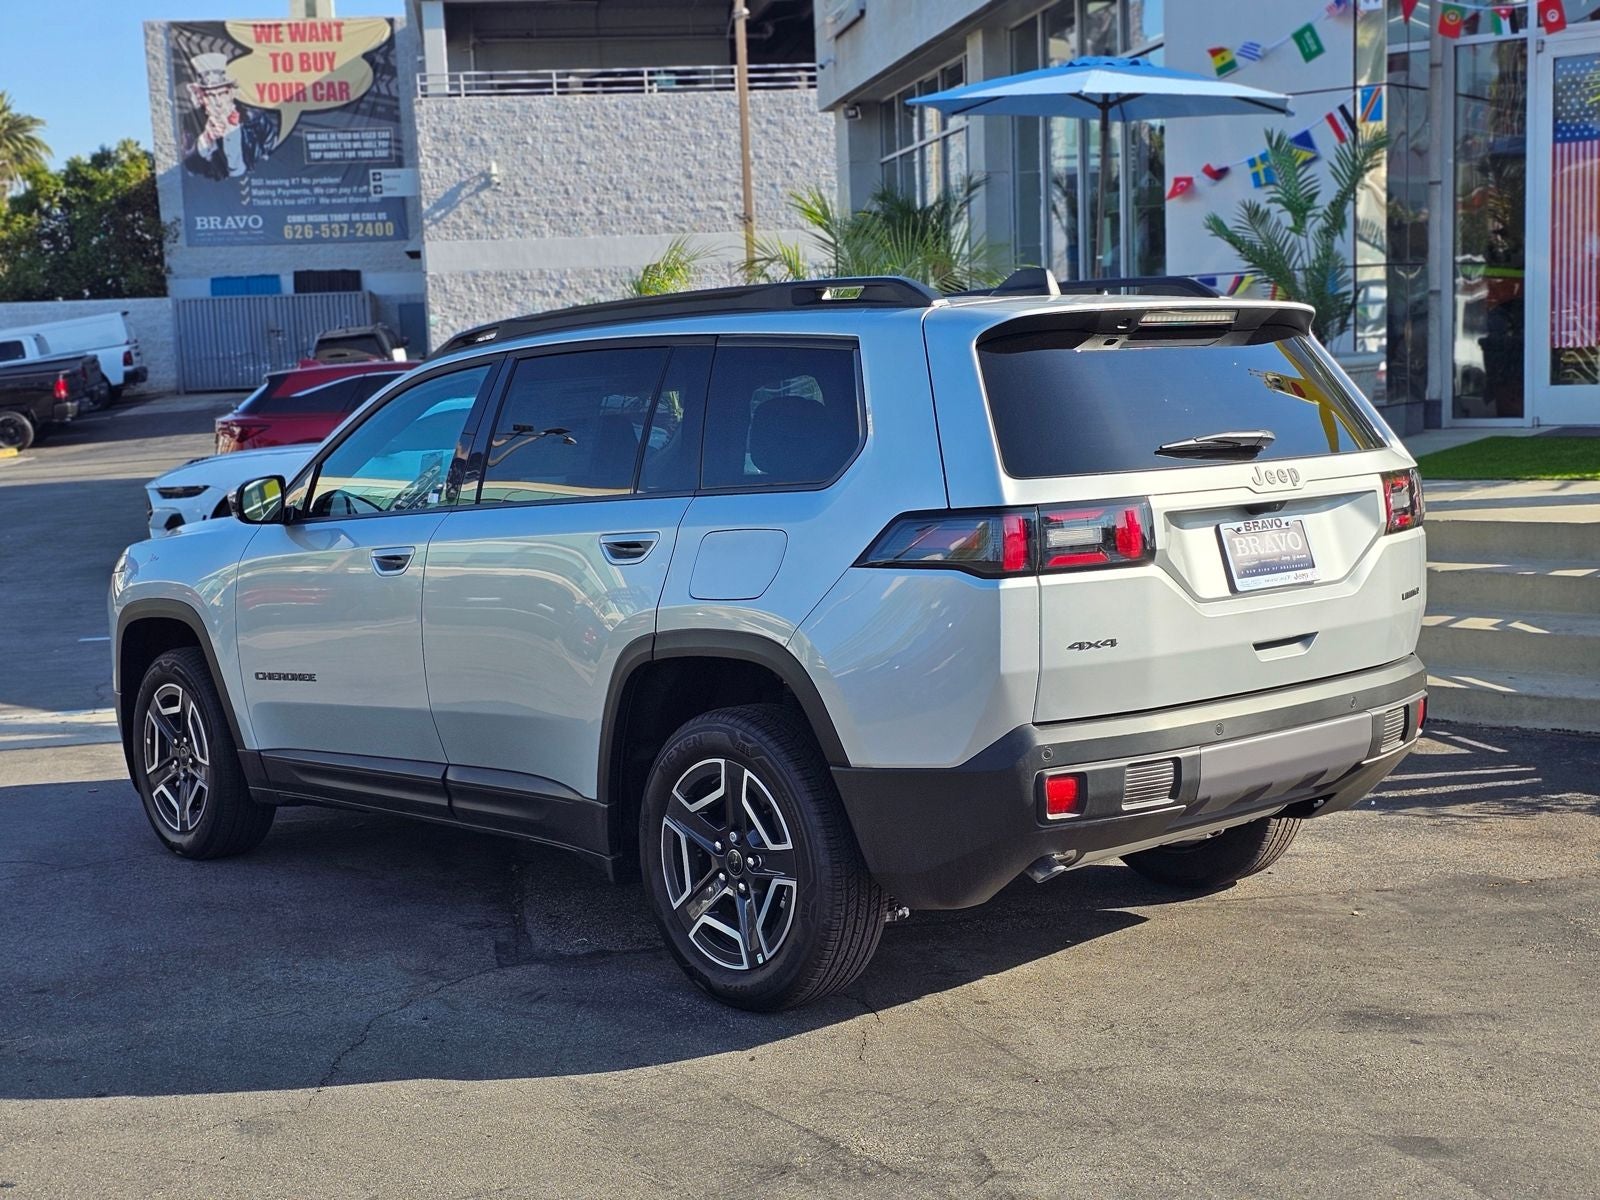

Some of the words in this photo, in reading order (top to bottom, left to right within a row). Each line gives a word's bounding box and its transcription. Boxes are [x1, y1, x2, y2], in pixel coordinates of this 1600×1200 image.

[253, 23, 283, 44] WE
[288, 22, 344, 43] WANT
[269, 52, 293, 73] TO
[300, 52, 336, 72] BUY
[256, 82, 307, 104] YOUR
[312, 81, 350, 102] CAR
[194, 214, 264, 230] BRAVO
[284, 222, 394, 239] 626-537-2400
[1251, 465, 1301, 487] Jeep
[1243, 518, 1283, 531] BRAVO
[1231, 531, 1303, 557] BRAVO
[255, 672, 317, 681] CHEROKEE
